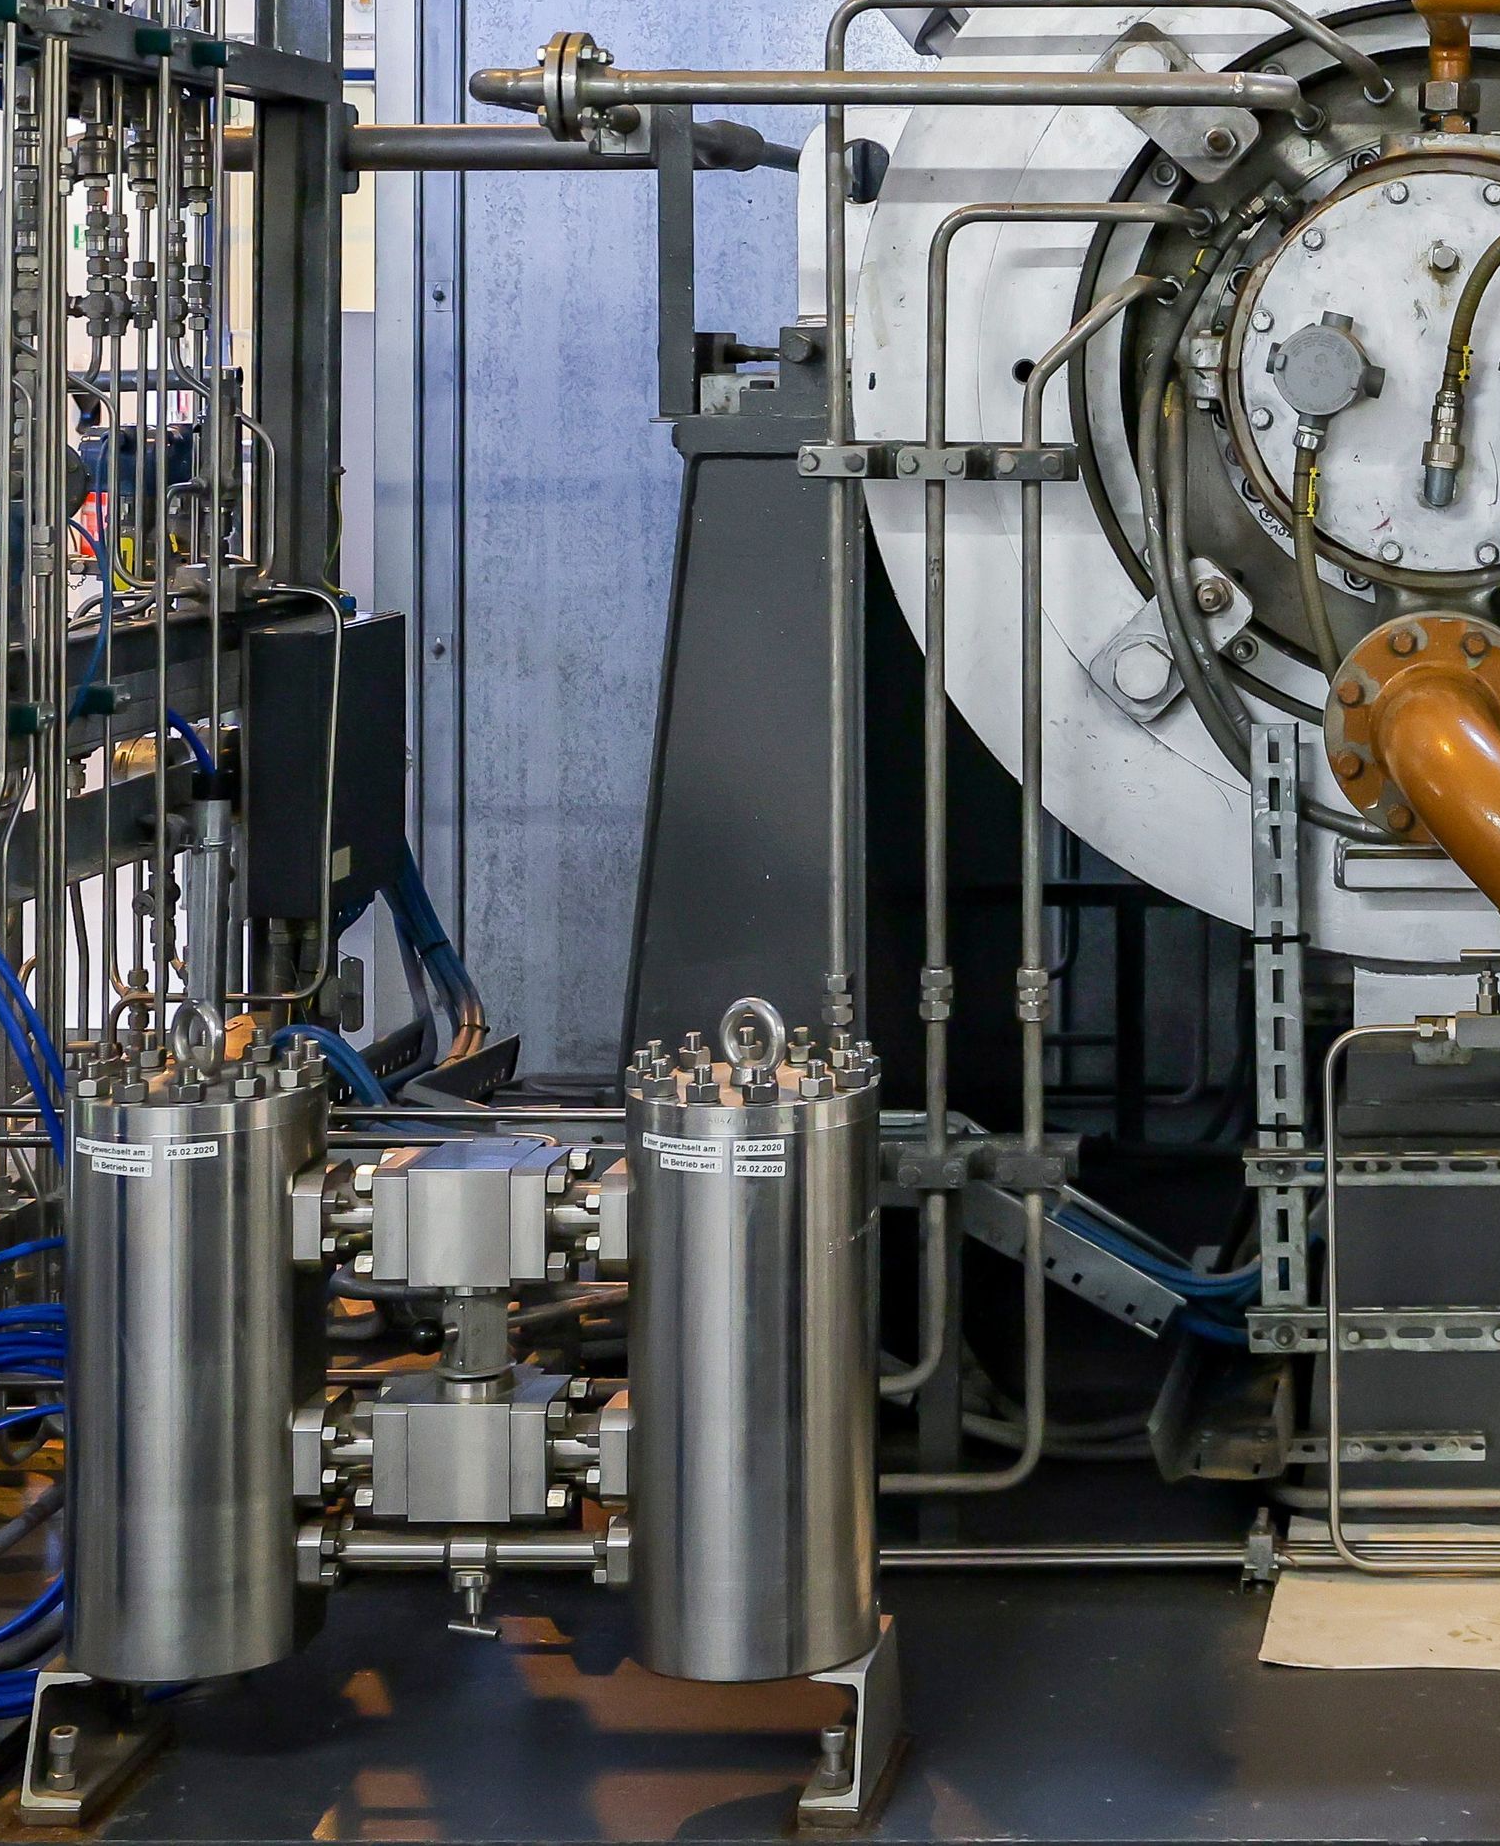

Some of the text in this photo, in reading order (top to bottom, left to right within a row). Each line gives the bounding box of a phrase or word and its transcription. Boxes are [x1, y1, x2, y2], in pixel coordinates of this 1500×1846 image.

[167, 1145, 215, 1157] 26.02.2020
[736, 1143, 782, 1153] 26.02.2020
[101, 1161, 127, 1171] Betrieb
[129, 1165, 145, 1173] seit
[670, 1158, 698, 1168] Betrieb
[737, 1164, 783, 1174] 26.02.2020
